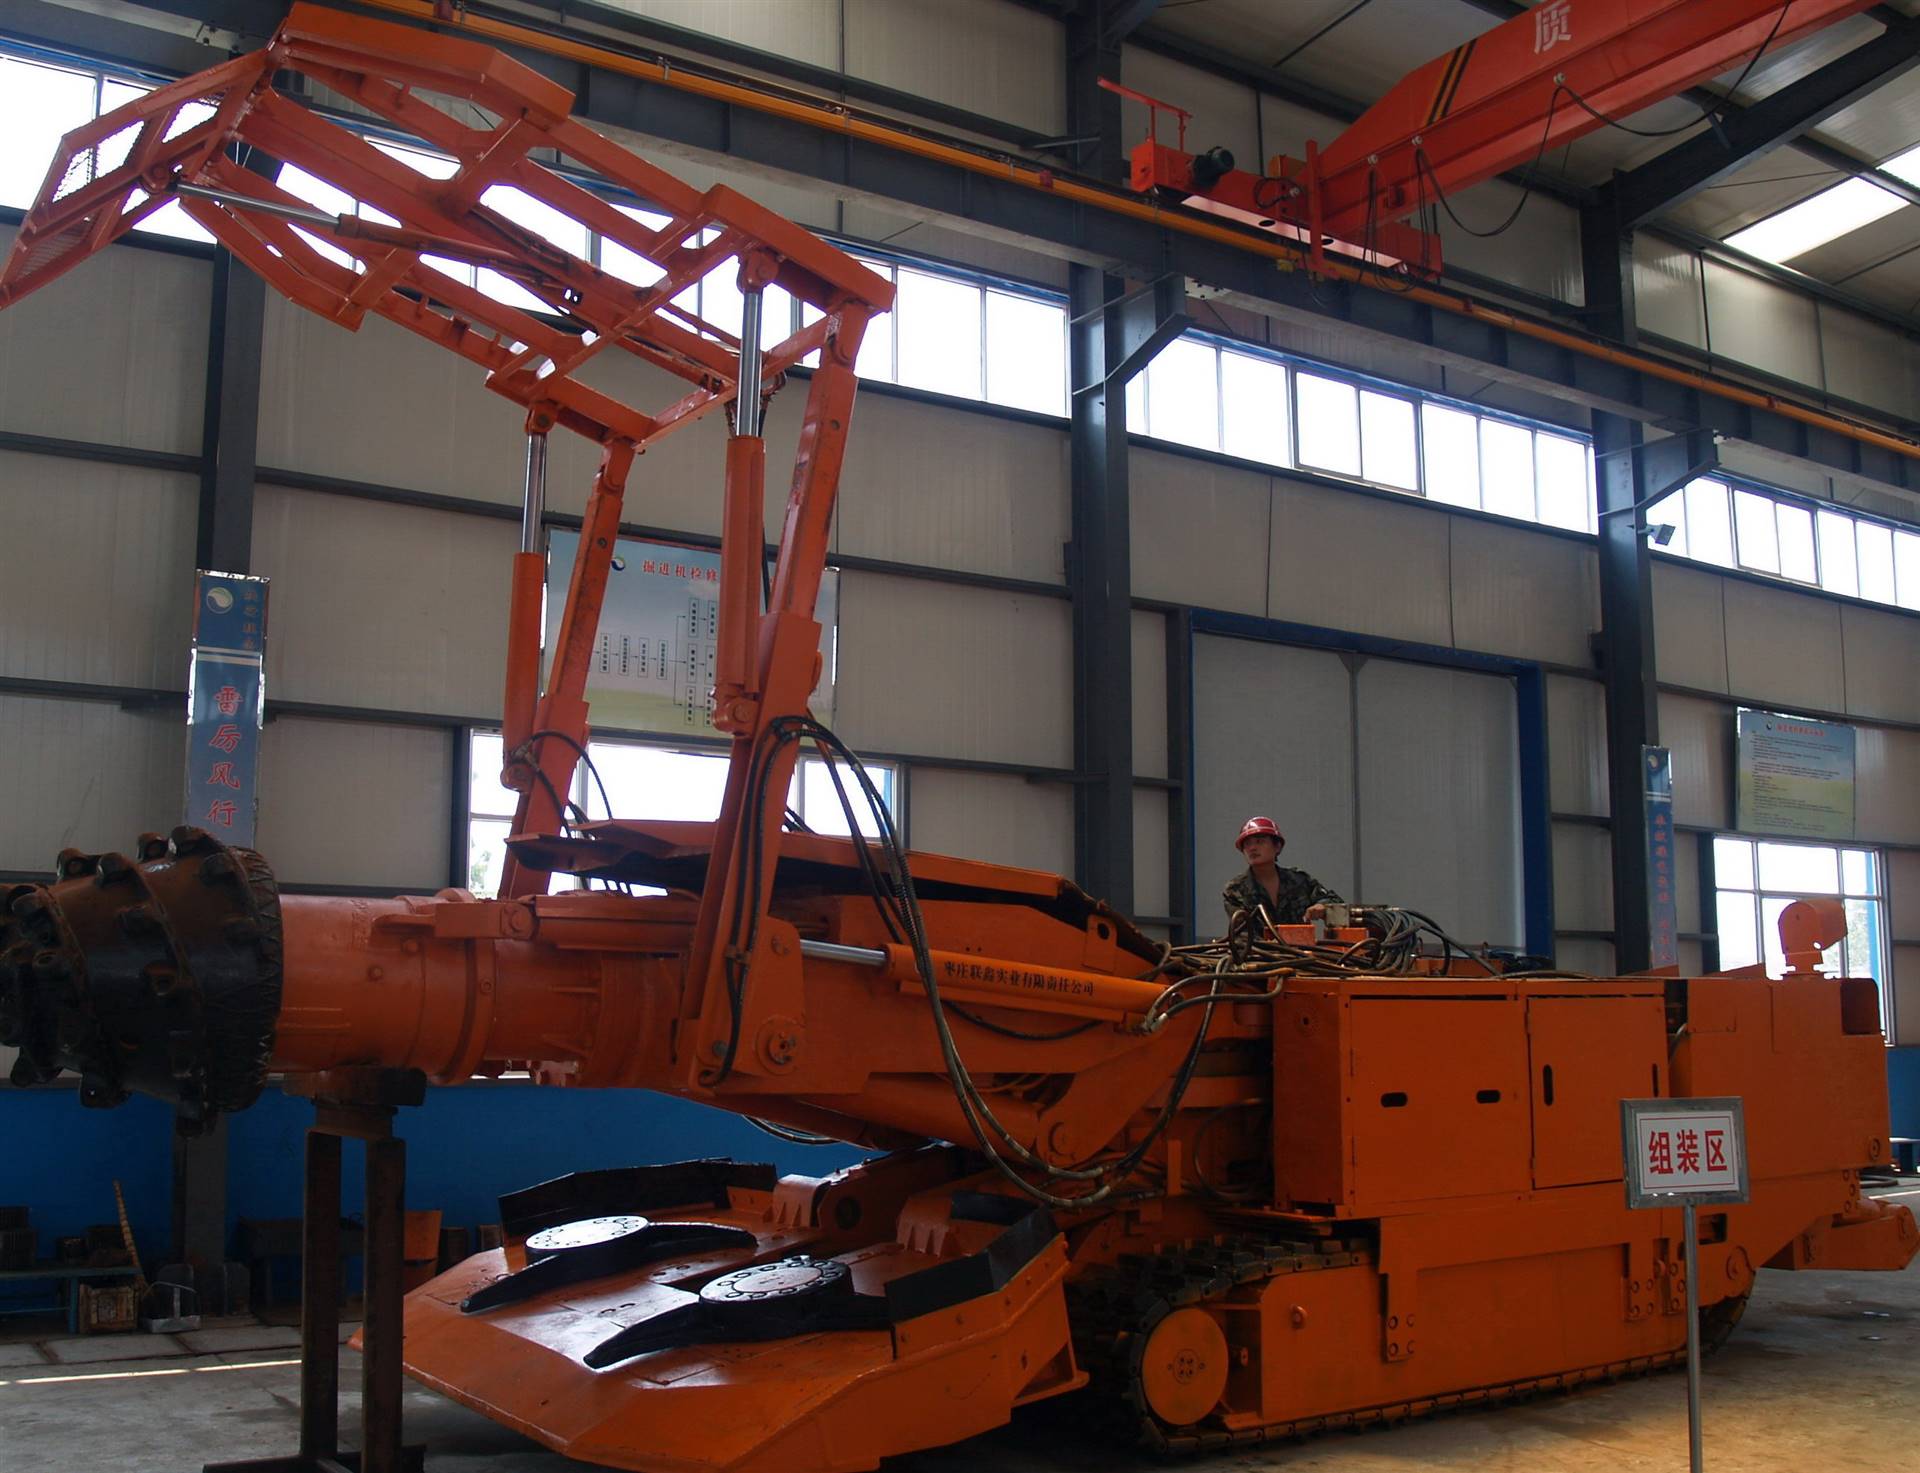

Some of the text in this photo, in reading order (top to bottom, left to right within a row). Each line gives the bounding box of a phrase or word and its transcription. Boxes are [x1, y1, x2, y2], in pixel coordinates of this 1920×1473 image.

[1534, 0, 1572, 54] 质
[205, 685, 244, 828] 雷厉风行
[1648, 1128, 1729, 1176] 组装区
